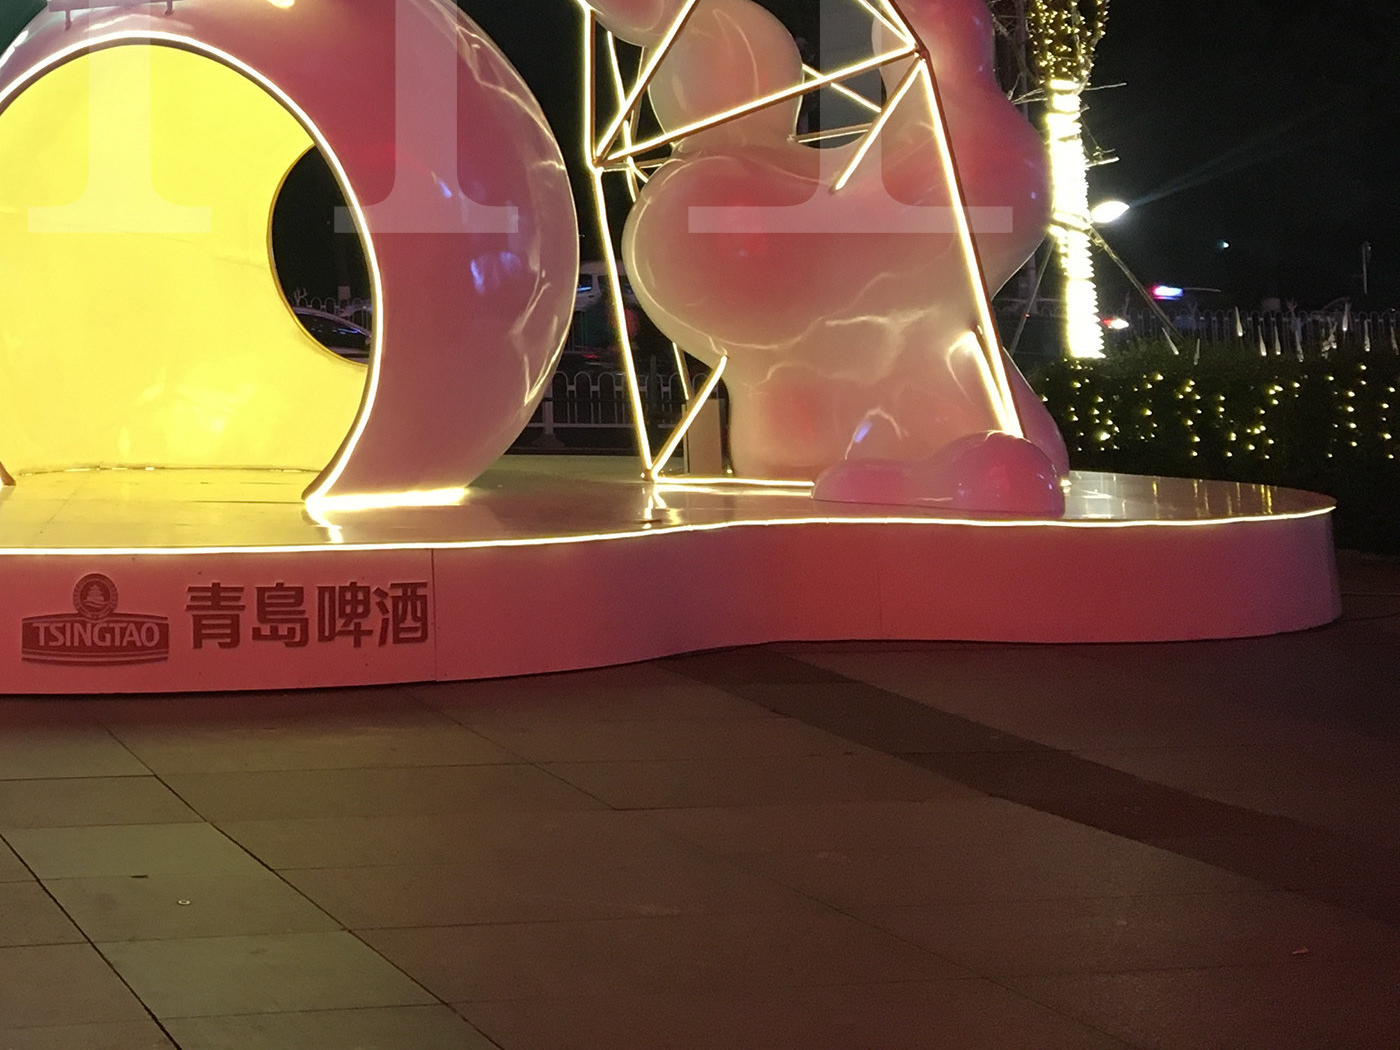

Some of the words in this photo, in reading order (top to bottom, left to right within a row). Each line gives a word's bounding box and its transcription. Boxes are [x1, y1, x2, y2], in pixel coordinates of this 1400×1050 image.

[33, 622, 160, 647] TSINGTAO
[185, 581, 428, 649] 青島啤酒
